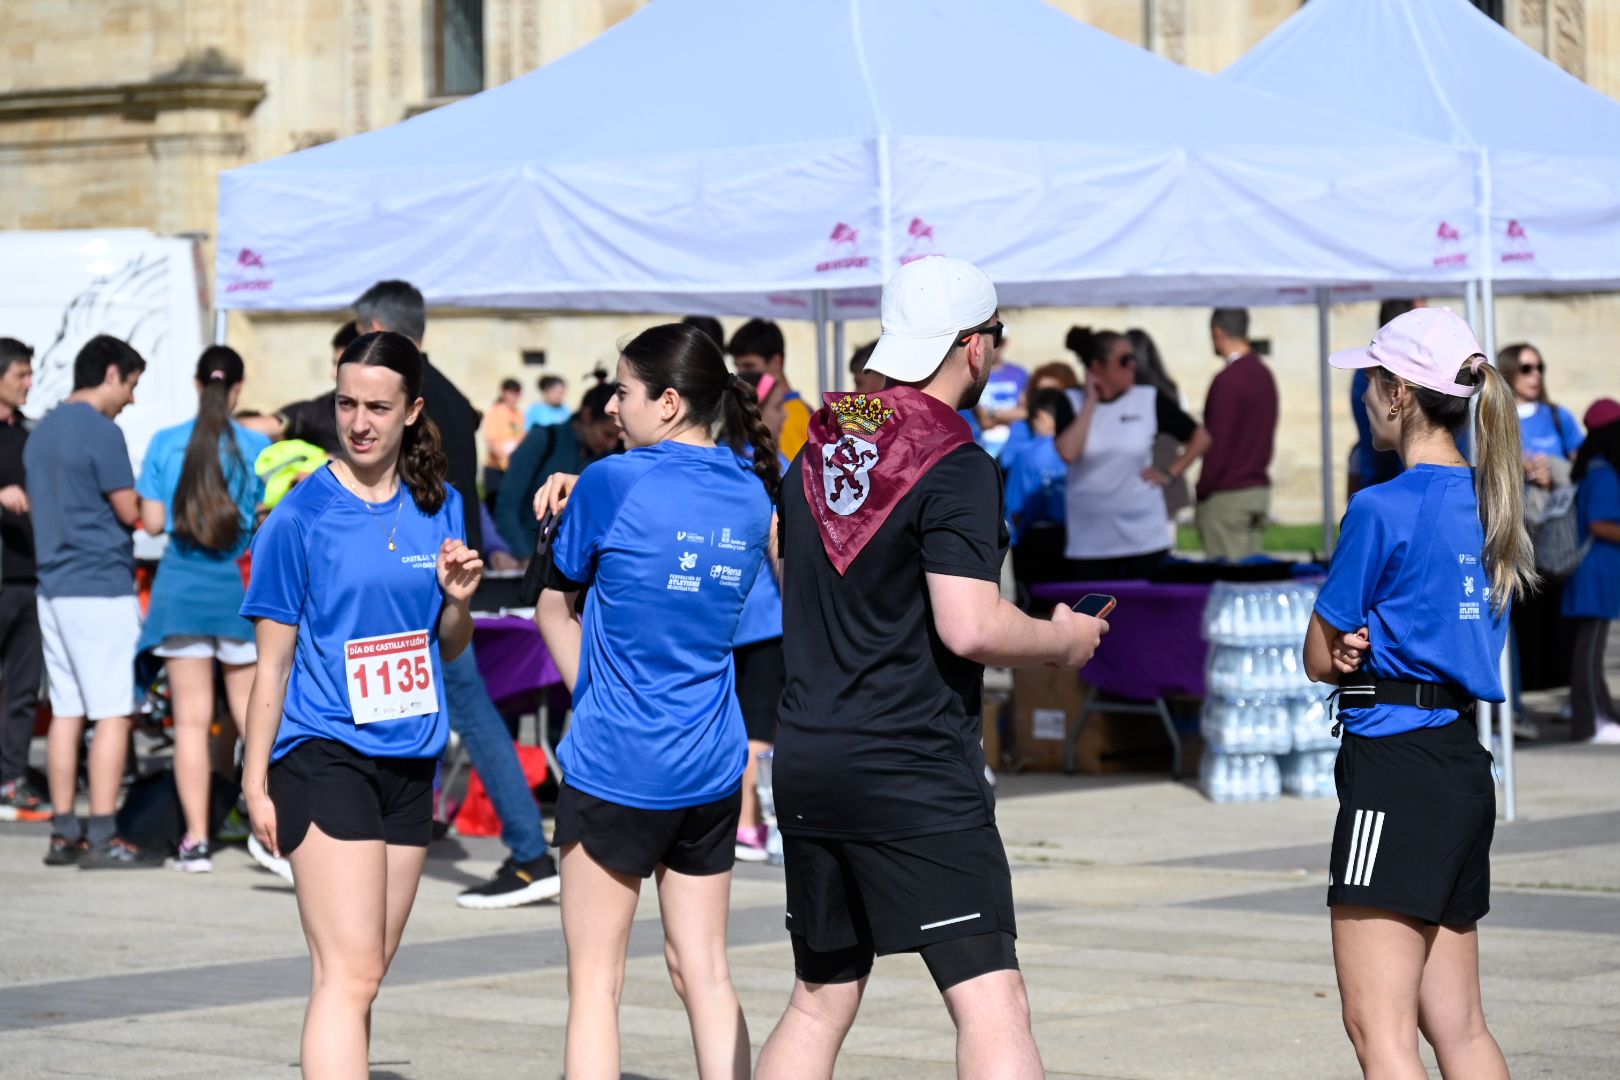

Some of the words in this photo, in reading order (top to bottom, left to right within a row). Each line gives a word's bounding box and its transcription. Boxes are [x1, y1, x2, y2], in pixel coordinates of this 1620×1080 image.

[722, 566, 742, 576] Plena
[350, 646, 363, 655] DÍA
[364, 645, 374, 653] DE
[376, 641, 406, 651] CASTILLA
[410, 637, 425, 647] LEÓN
[353, 656, 430, 698] 1135
